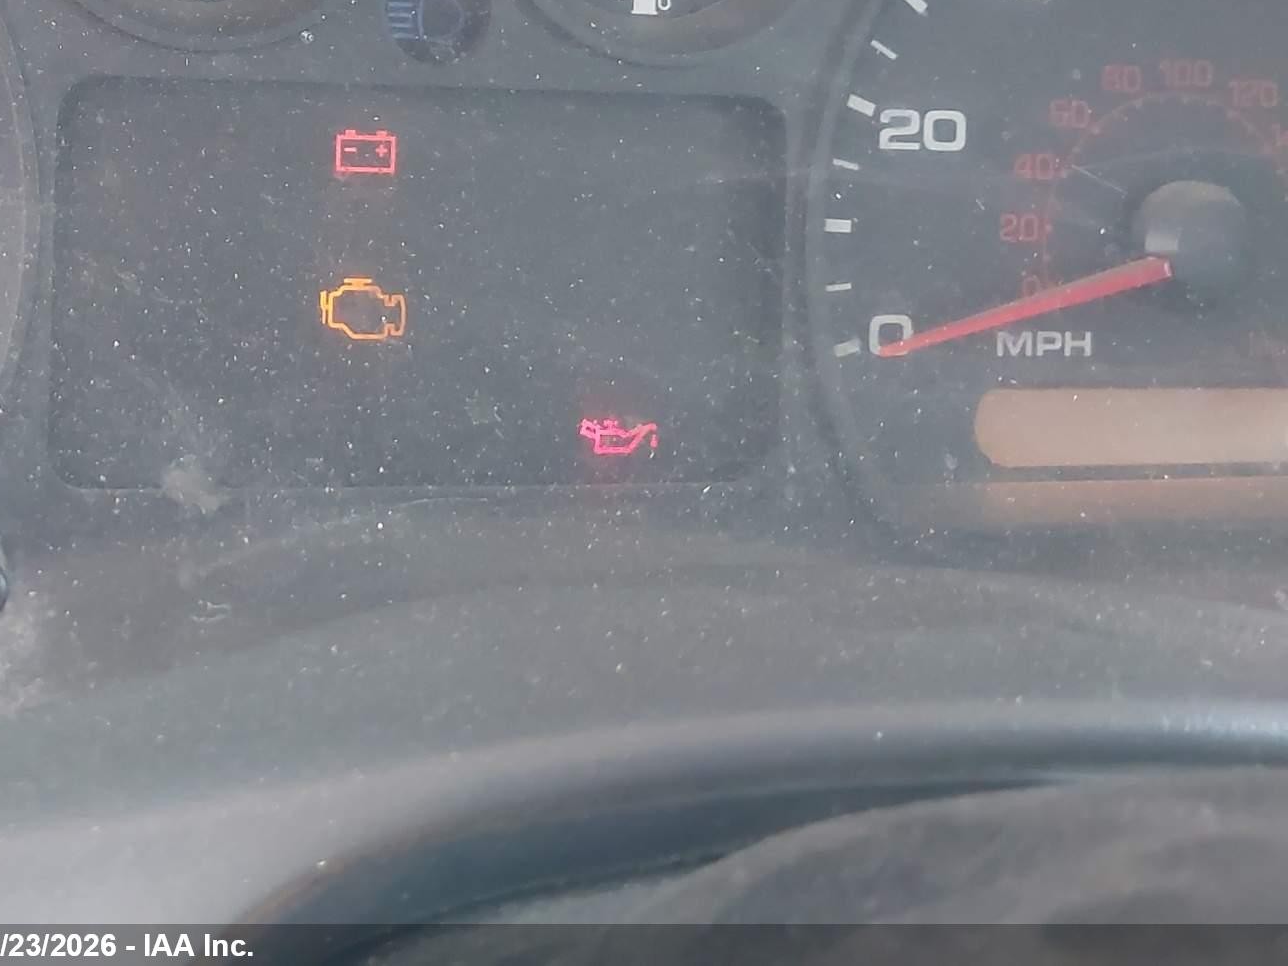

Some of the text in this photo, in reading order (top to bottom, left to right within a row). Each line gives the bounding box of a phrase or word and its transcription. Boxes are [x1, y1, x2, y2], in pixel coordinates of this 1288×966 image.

[878, 109, 967, 152] 20
[1014, 154, 1055, 180] 40
[1000, 213, 1040, 241] 20
[869, 314, 913, 356] 0
[995, 330, 1093, 357] MPH
